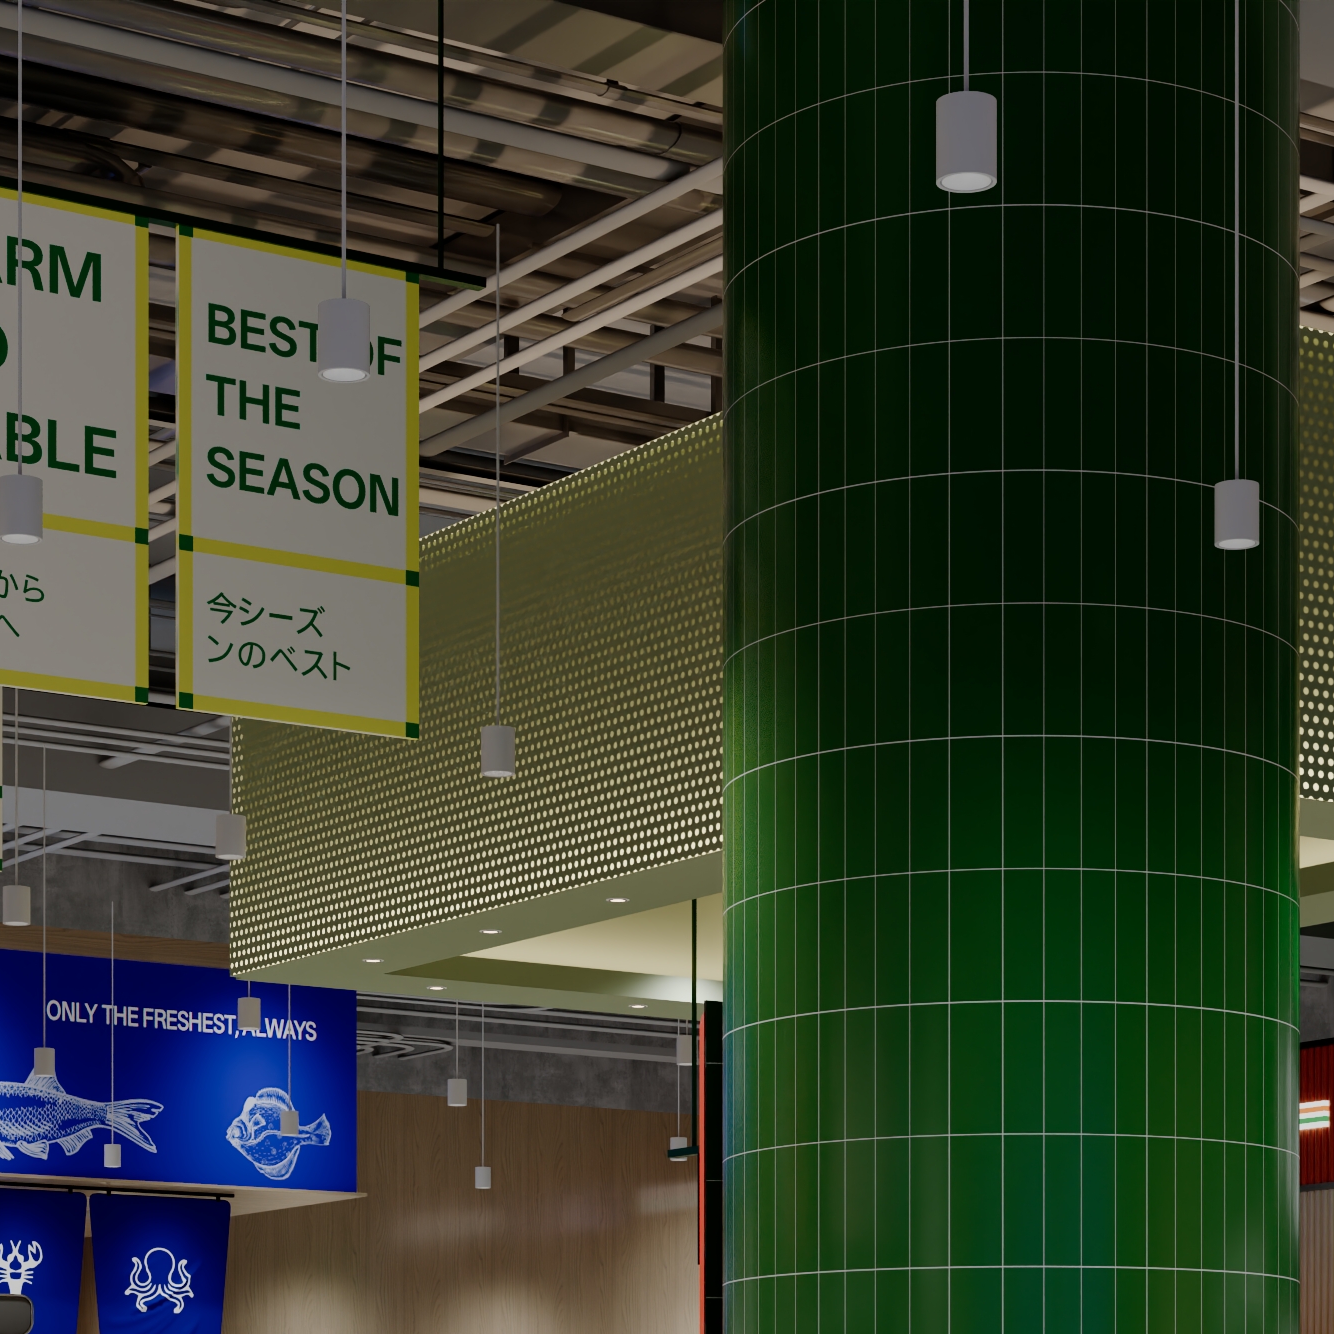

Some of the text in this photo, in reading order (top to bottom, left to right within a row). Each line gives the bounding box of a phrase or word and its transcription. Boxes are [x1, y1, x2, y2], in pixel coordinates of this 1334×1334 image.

[207, 302, 318, 363] BEST
[205, 373, 301, 430] THE
[206, 446, 400, 516] SEASON
[206, 591, 325, 638] 今シーズ
[207, 634, 351, 681] ンのベスト
[46, 1000, 317, 1041] ONLY THE FRESHEST, WAYS
